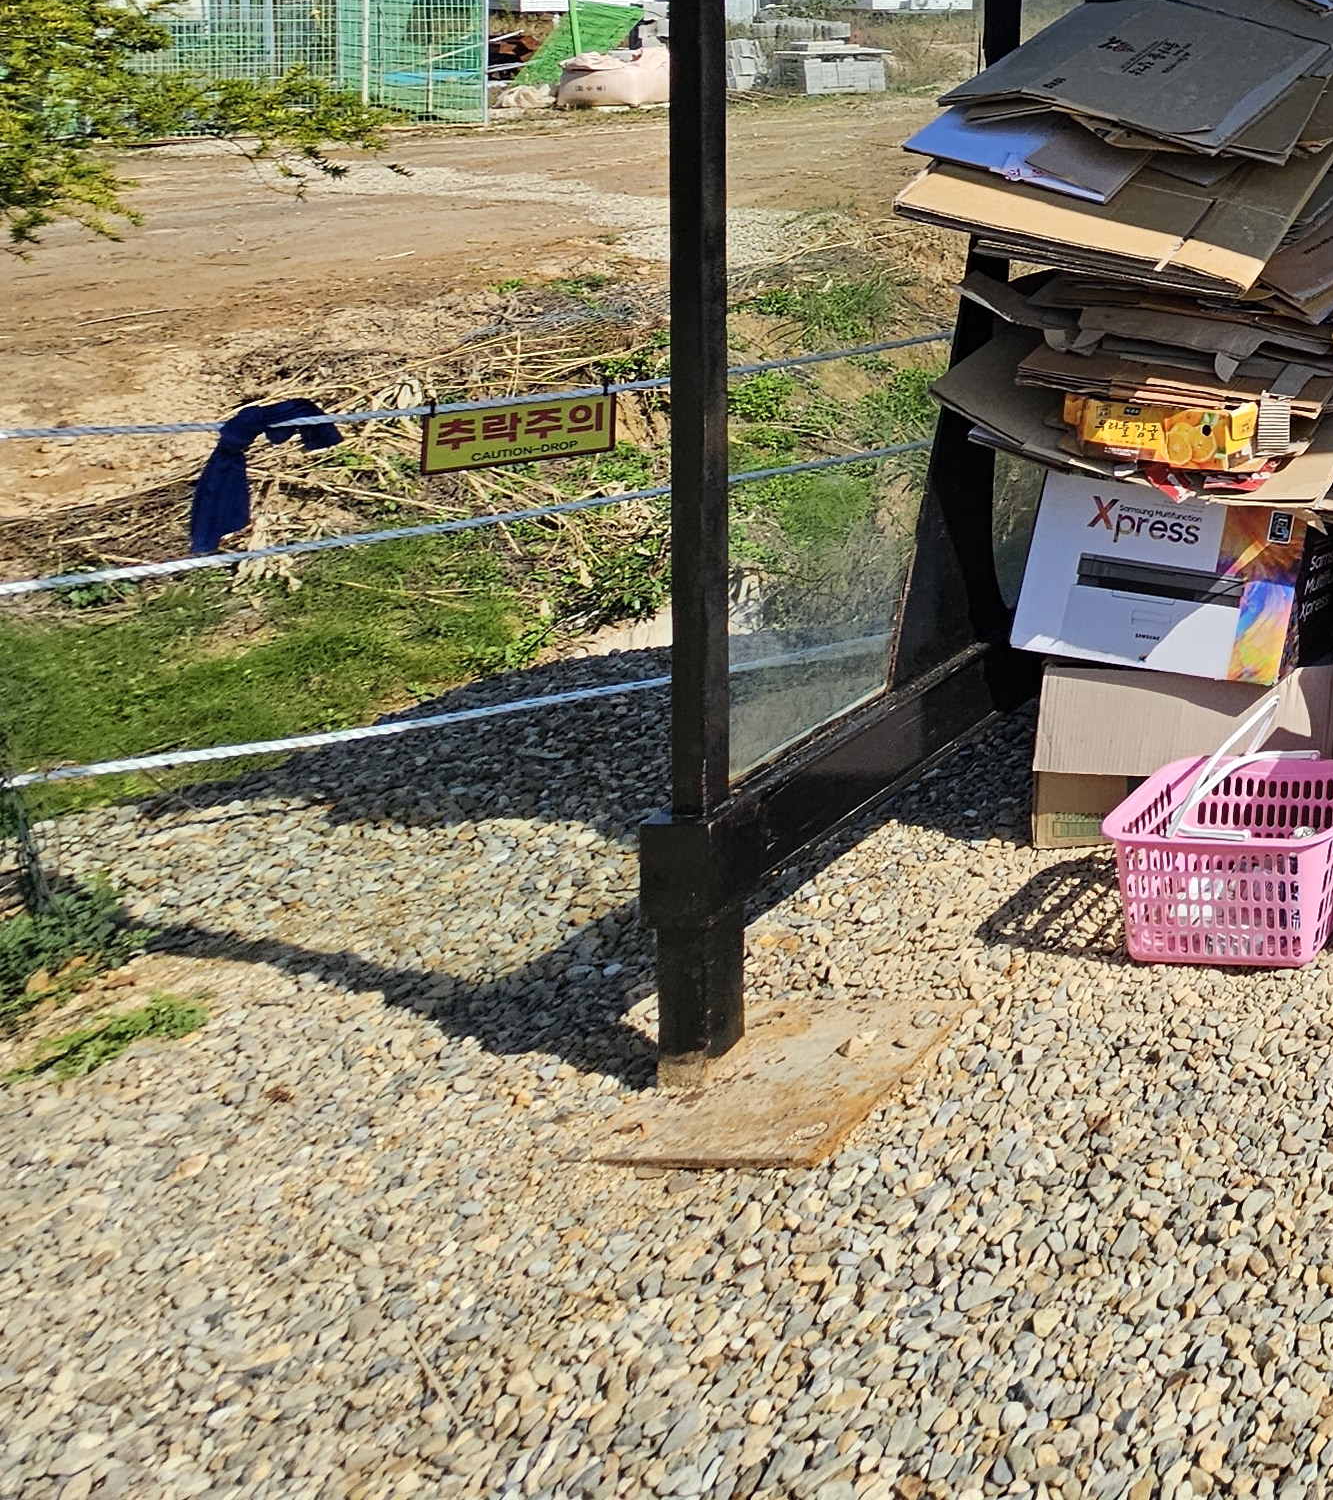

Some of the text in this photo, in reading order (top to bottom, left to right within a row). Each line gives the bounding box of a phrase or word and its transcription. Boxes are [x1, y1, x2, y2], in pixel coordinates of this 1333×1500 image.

[436, 402, 604, 451] 추락주의
[471, 440, 578, 462] CAUTION-DROP
[1087, 495, 1201, 545] Xpress
[1120, 504, 1154, 517] Samsung
[1155, 510, 1203, 523] Multifunction
